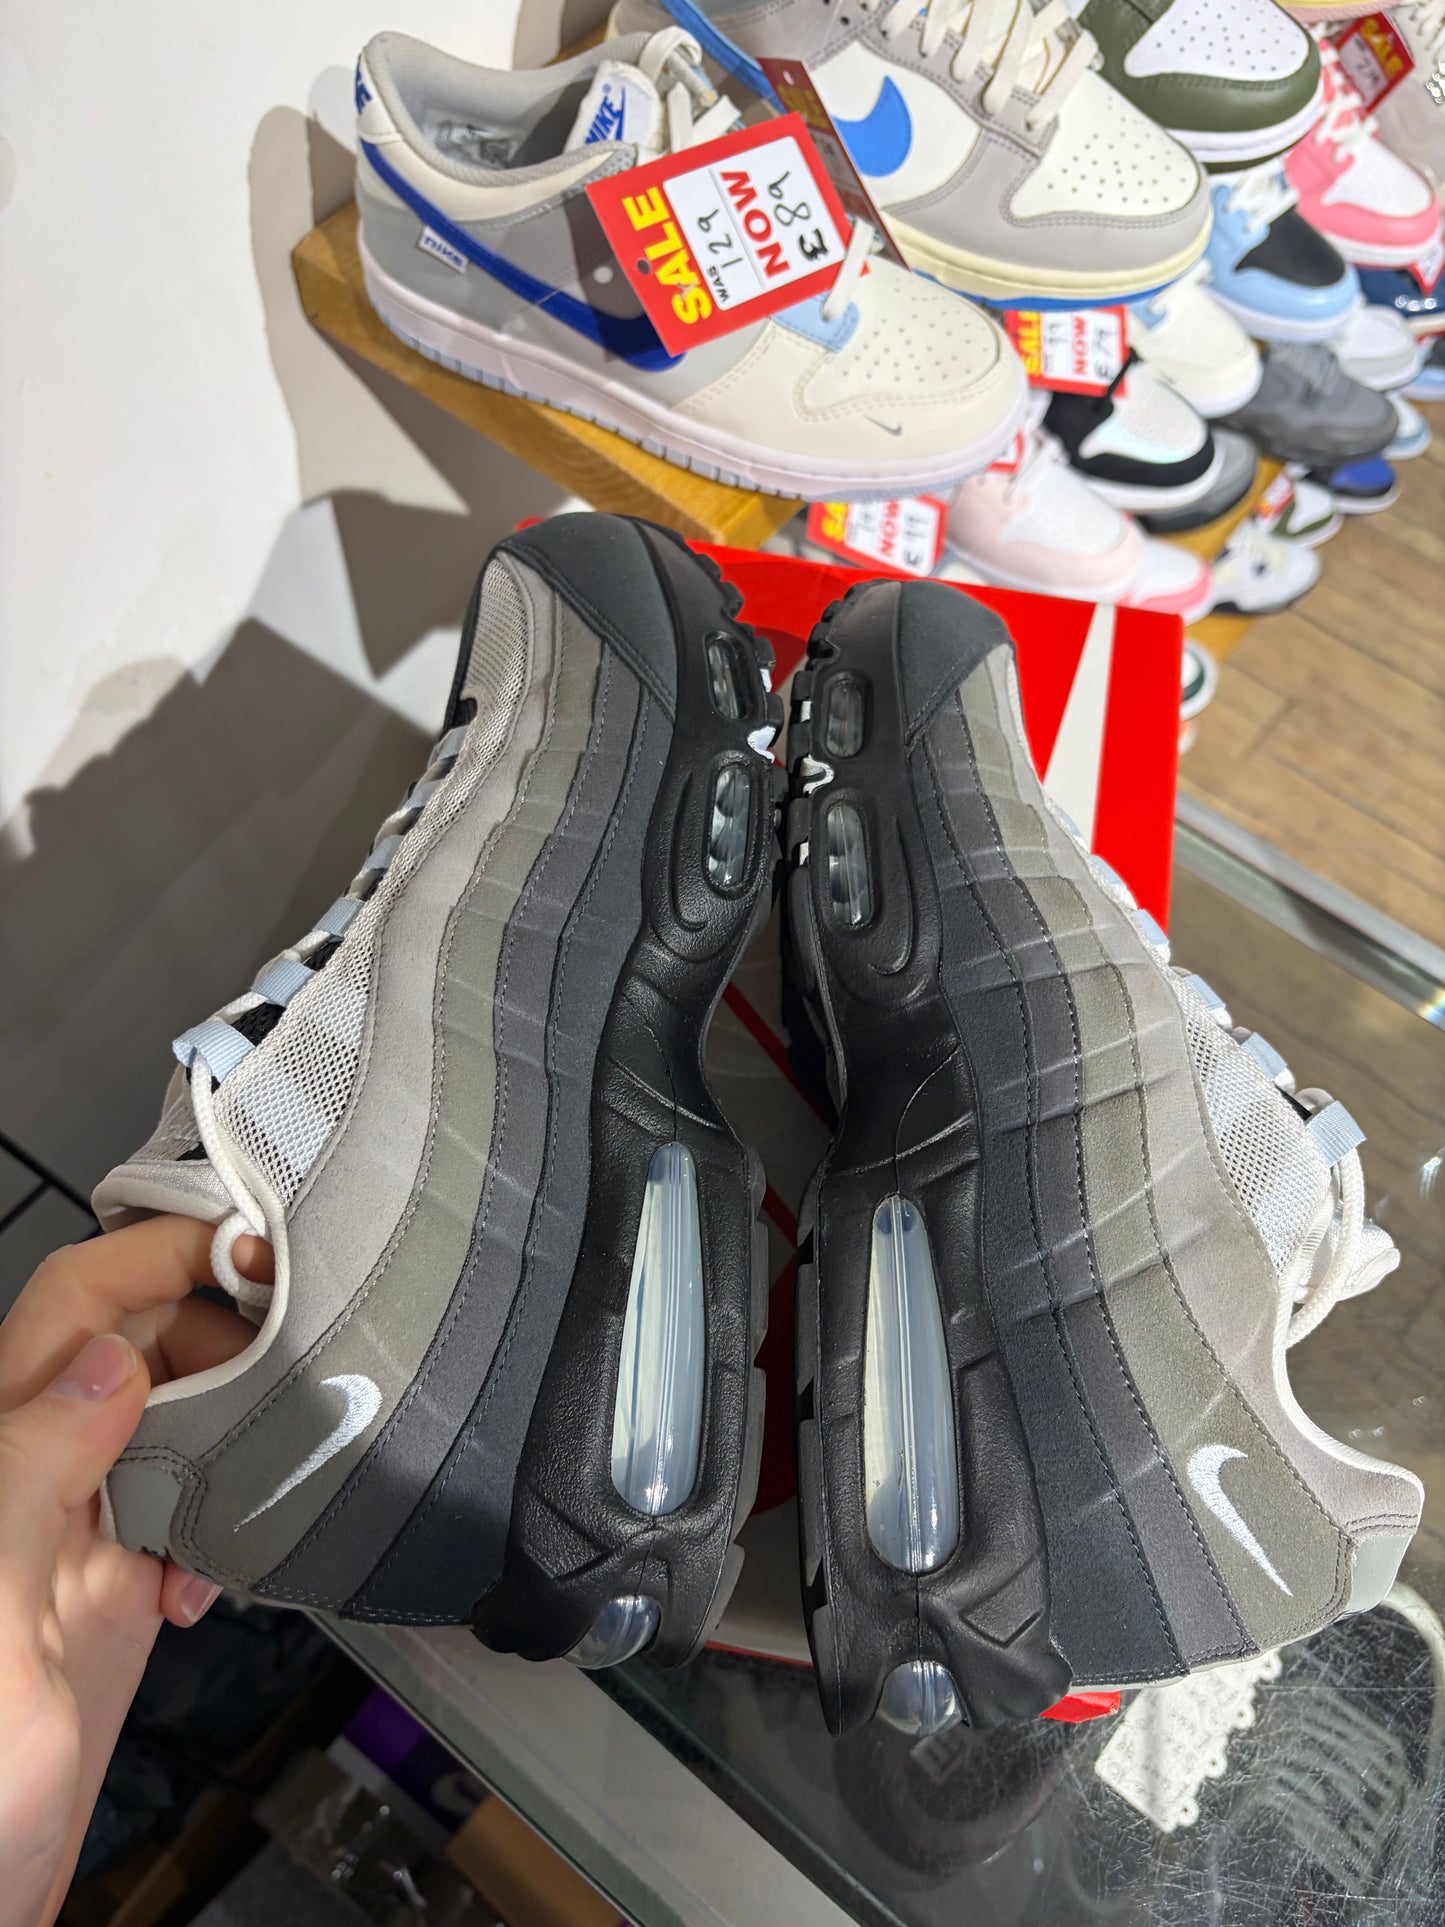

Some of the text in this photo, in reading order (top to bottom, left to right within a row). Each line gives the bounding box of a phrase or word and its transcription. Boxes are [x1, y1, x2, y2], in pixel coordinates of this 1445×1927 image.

[585, 95, 620, 144] NIKE
[621, 186, 713, 324] SALE
[697, 208, 744, 302] WAS 129
[719, 170, 791, 279] NOW
[1073, 315, 1089, 376] NOW
